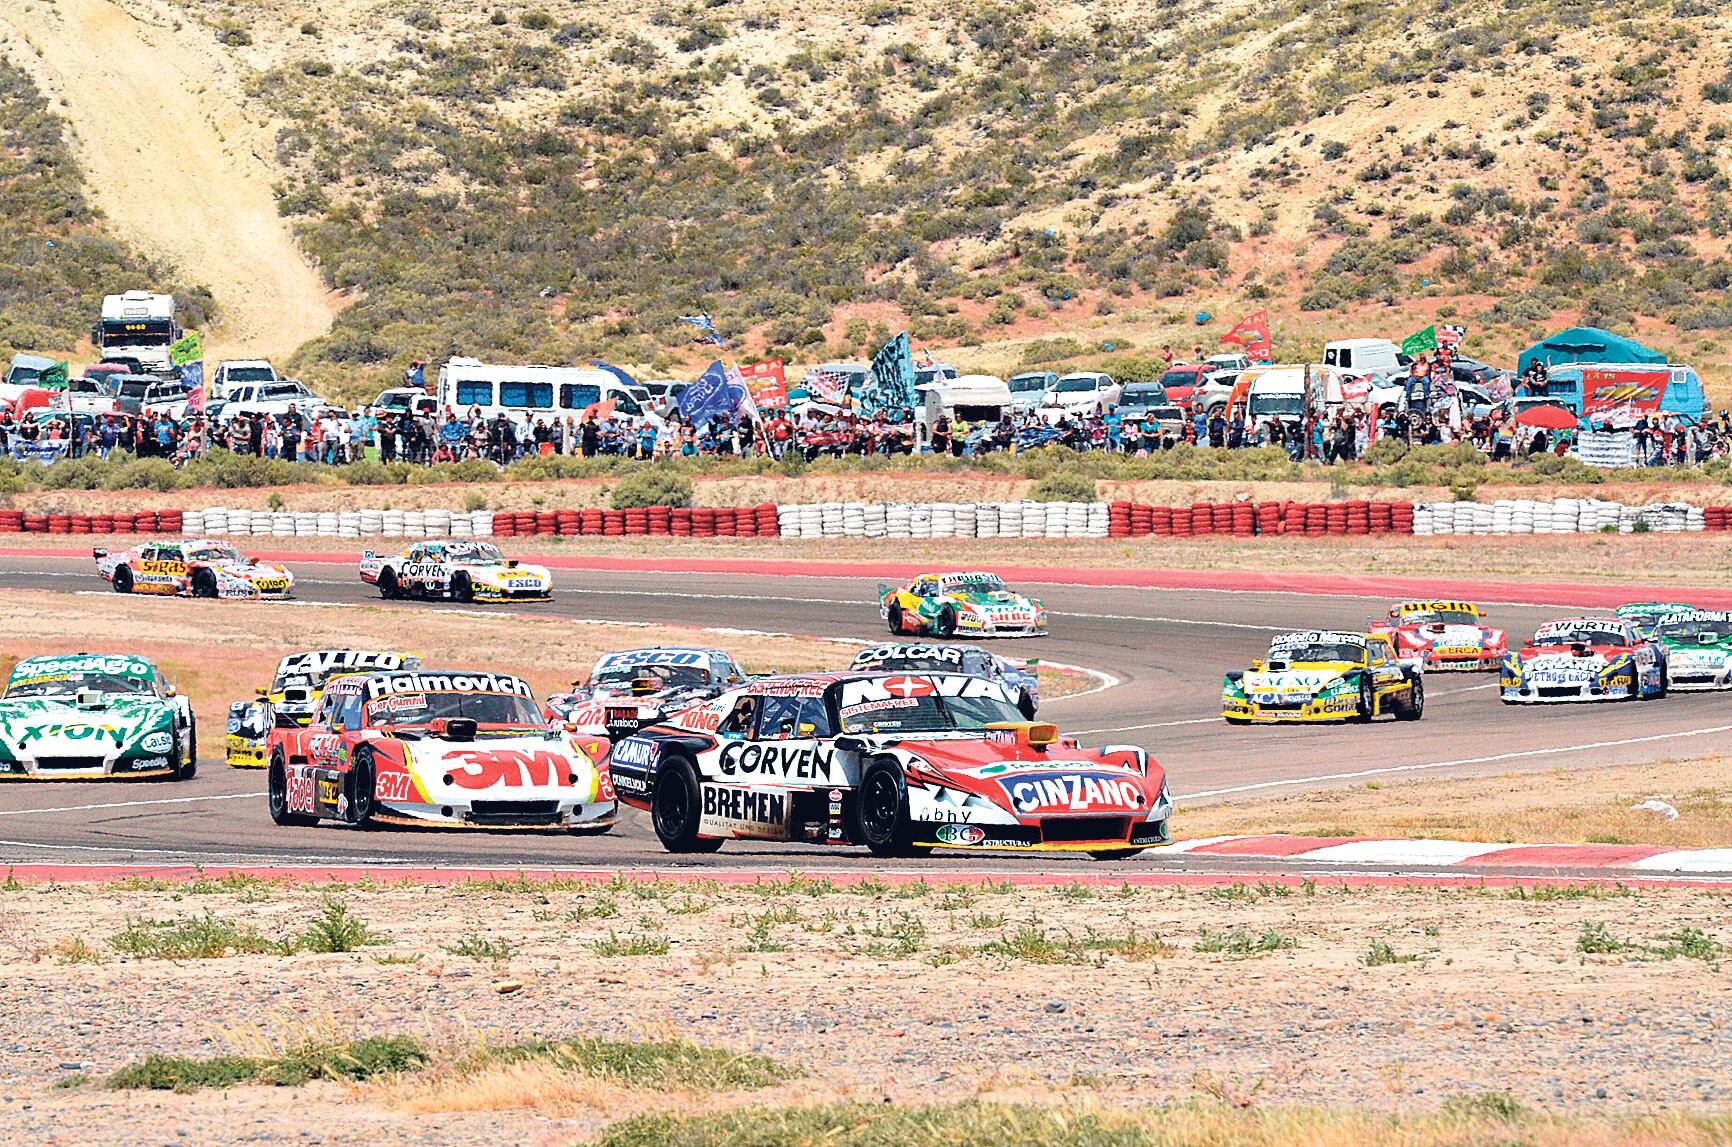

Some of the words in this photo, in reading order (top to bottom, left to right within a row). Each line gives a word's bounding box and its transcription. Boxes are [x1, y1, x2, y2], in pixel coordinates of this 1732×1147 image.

[602, 653, 702, 668] ESCO
[854, 648, 962, 664] COLCAR
[12, 658, 148, 679] SpeedAgro
[368, 673, 533, 699] Haimovich
[841, 700, 916, 717] SISTEMAFREE
[680, 711, 720, 731] KING
[16, 723, 128, 746] XION
[442, 749, 576, 790] 3M
[719, 741, 834, 783] CORVEN
[376, 771, 412, 801] 3M
[1014, 775, 1142, 812] CINZANO
[704, 786, 784, 826] BREMEN
